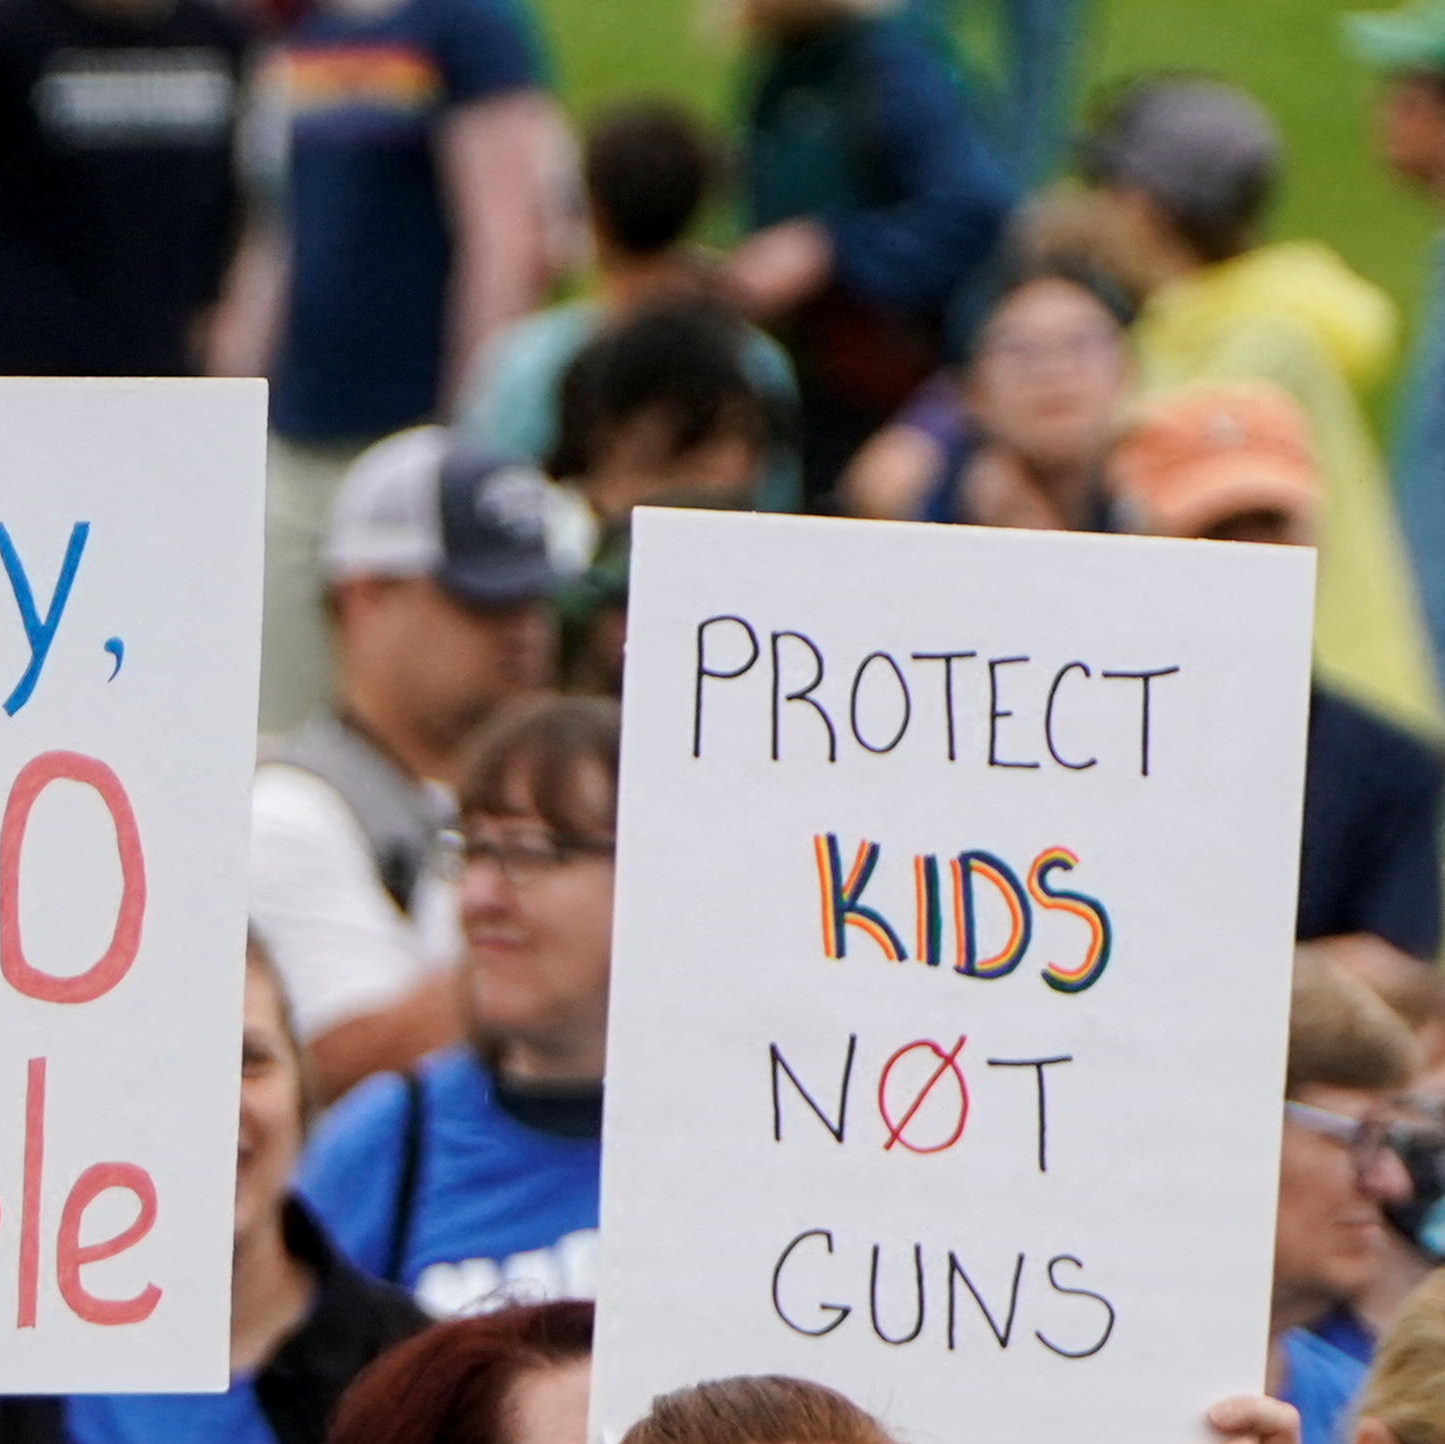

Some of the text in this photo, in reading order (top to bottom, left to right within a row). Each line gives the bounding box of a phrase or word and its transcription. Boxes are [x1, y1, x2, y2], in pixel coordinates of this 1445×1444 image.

[692, 615, 1180, 777] PROTECT
[813, 832, 1112, 993] KIDS
[772, 1229, 1115, 1358] GUNS
